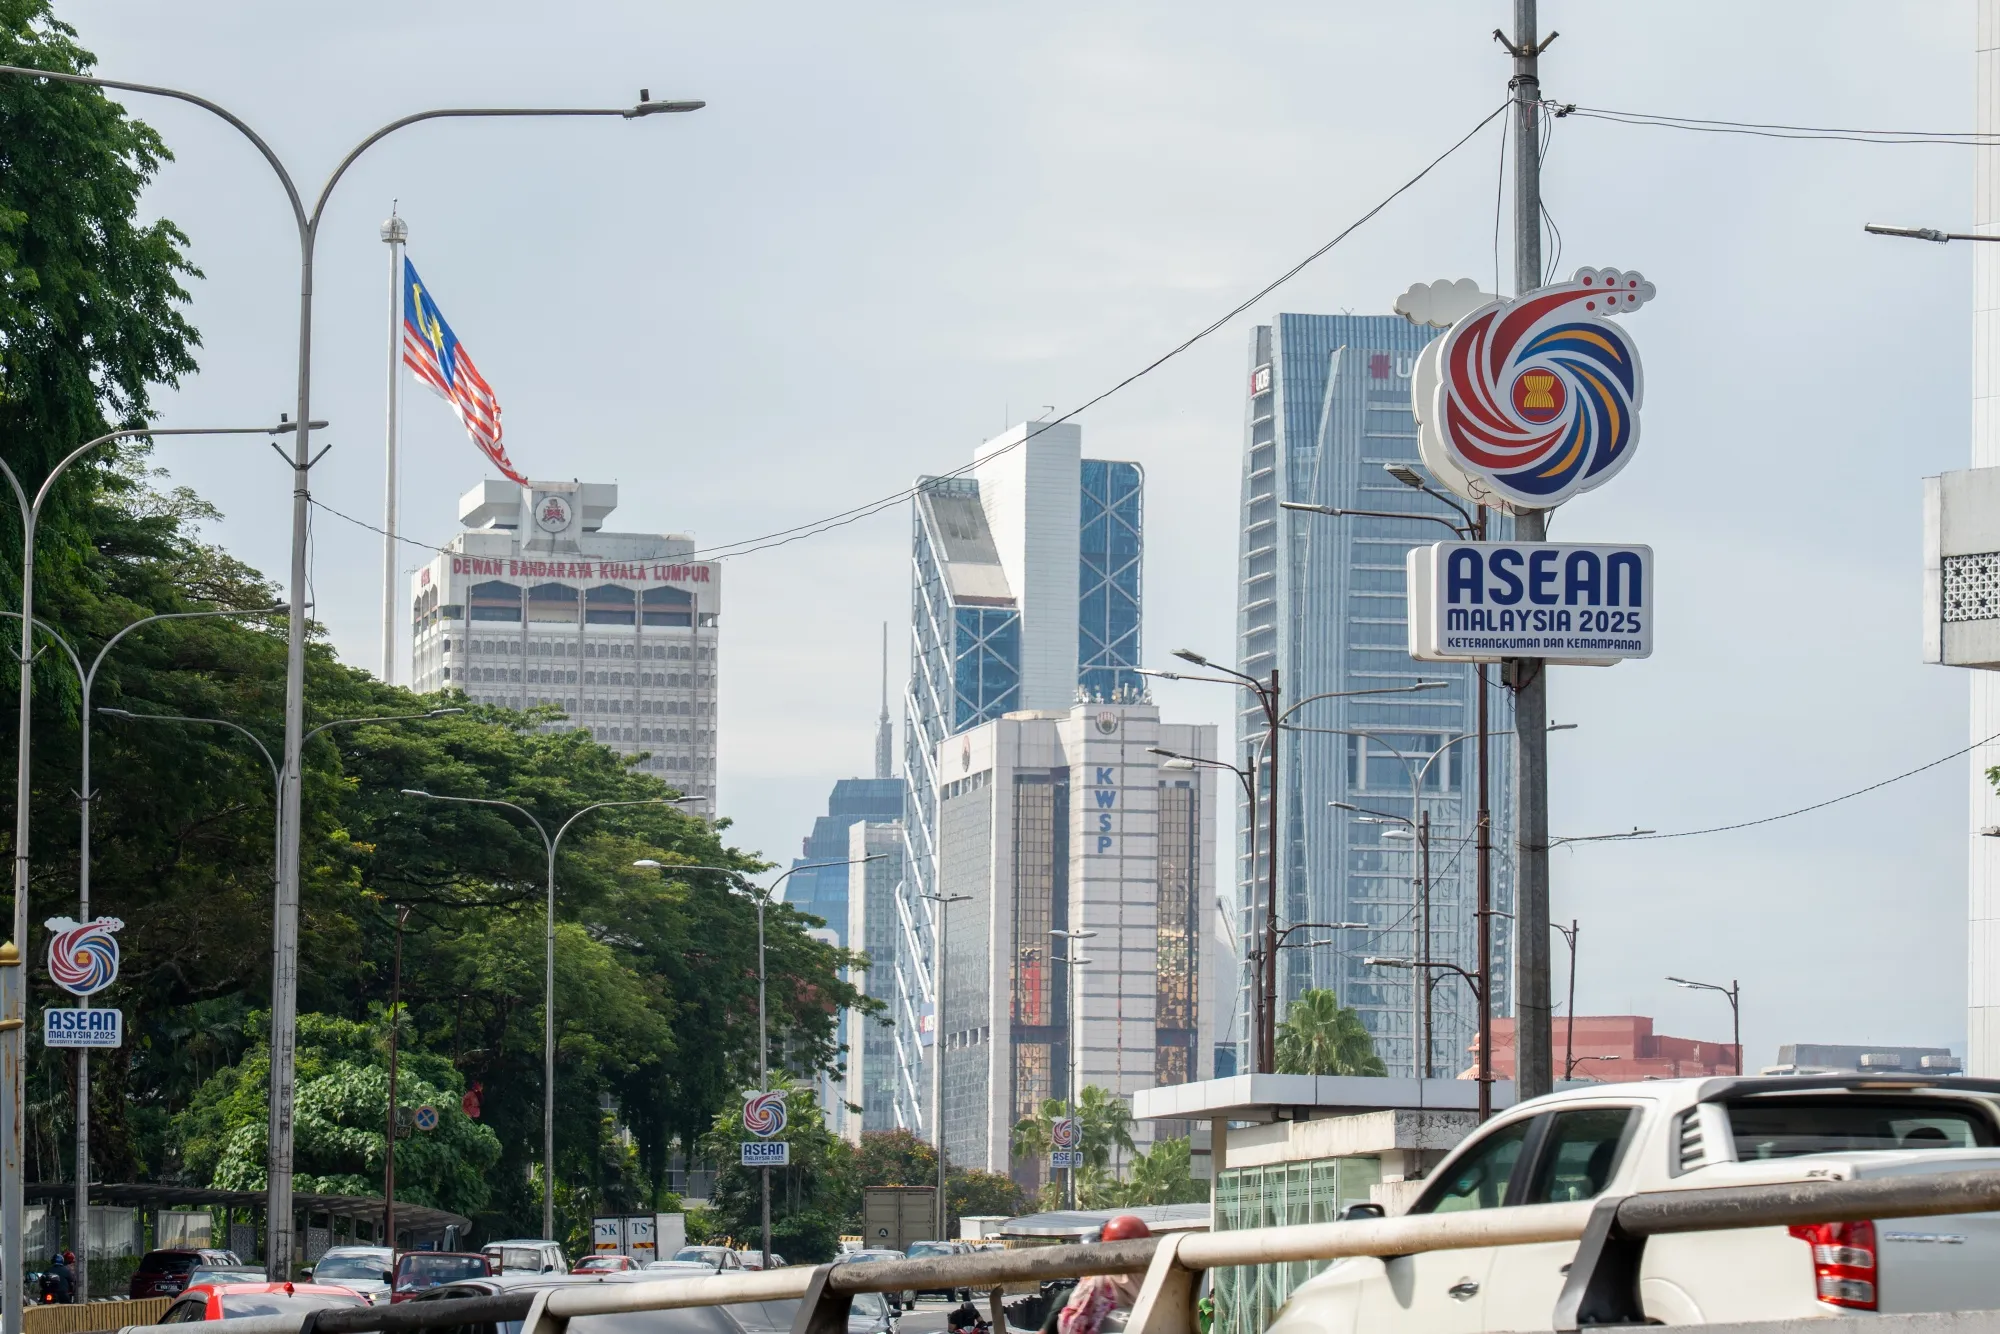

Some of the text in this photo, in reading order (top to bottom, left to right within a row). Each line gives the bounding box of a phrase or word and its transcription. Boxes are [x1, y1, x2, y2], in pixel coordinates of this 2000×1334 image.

[453, 558, 710, 583] DEWAN BANDARAYA KUALA LUMPUR
[1447, 547, 1642, 608] ASEAN
[1447, 608, 1642, 634] MALAYSIA 2025
[1447, 637, 1642, 651] KETERANGKUMAN DAN KEMAMPANAN
[1094, 767, 1116, 854] KWSP
[48, 1011, 116, 1031] ASEAN
[48, 1030, 116, 1040] MALAYSIA 2025
[744, 1143, 784, 1156] ASEAN
[1052, 1152, 1082, 1162] ASEN
[601, 1222, 648, 1236] SK TS
